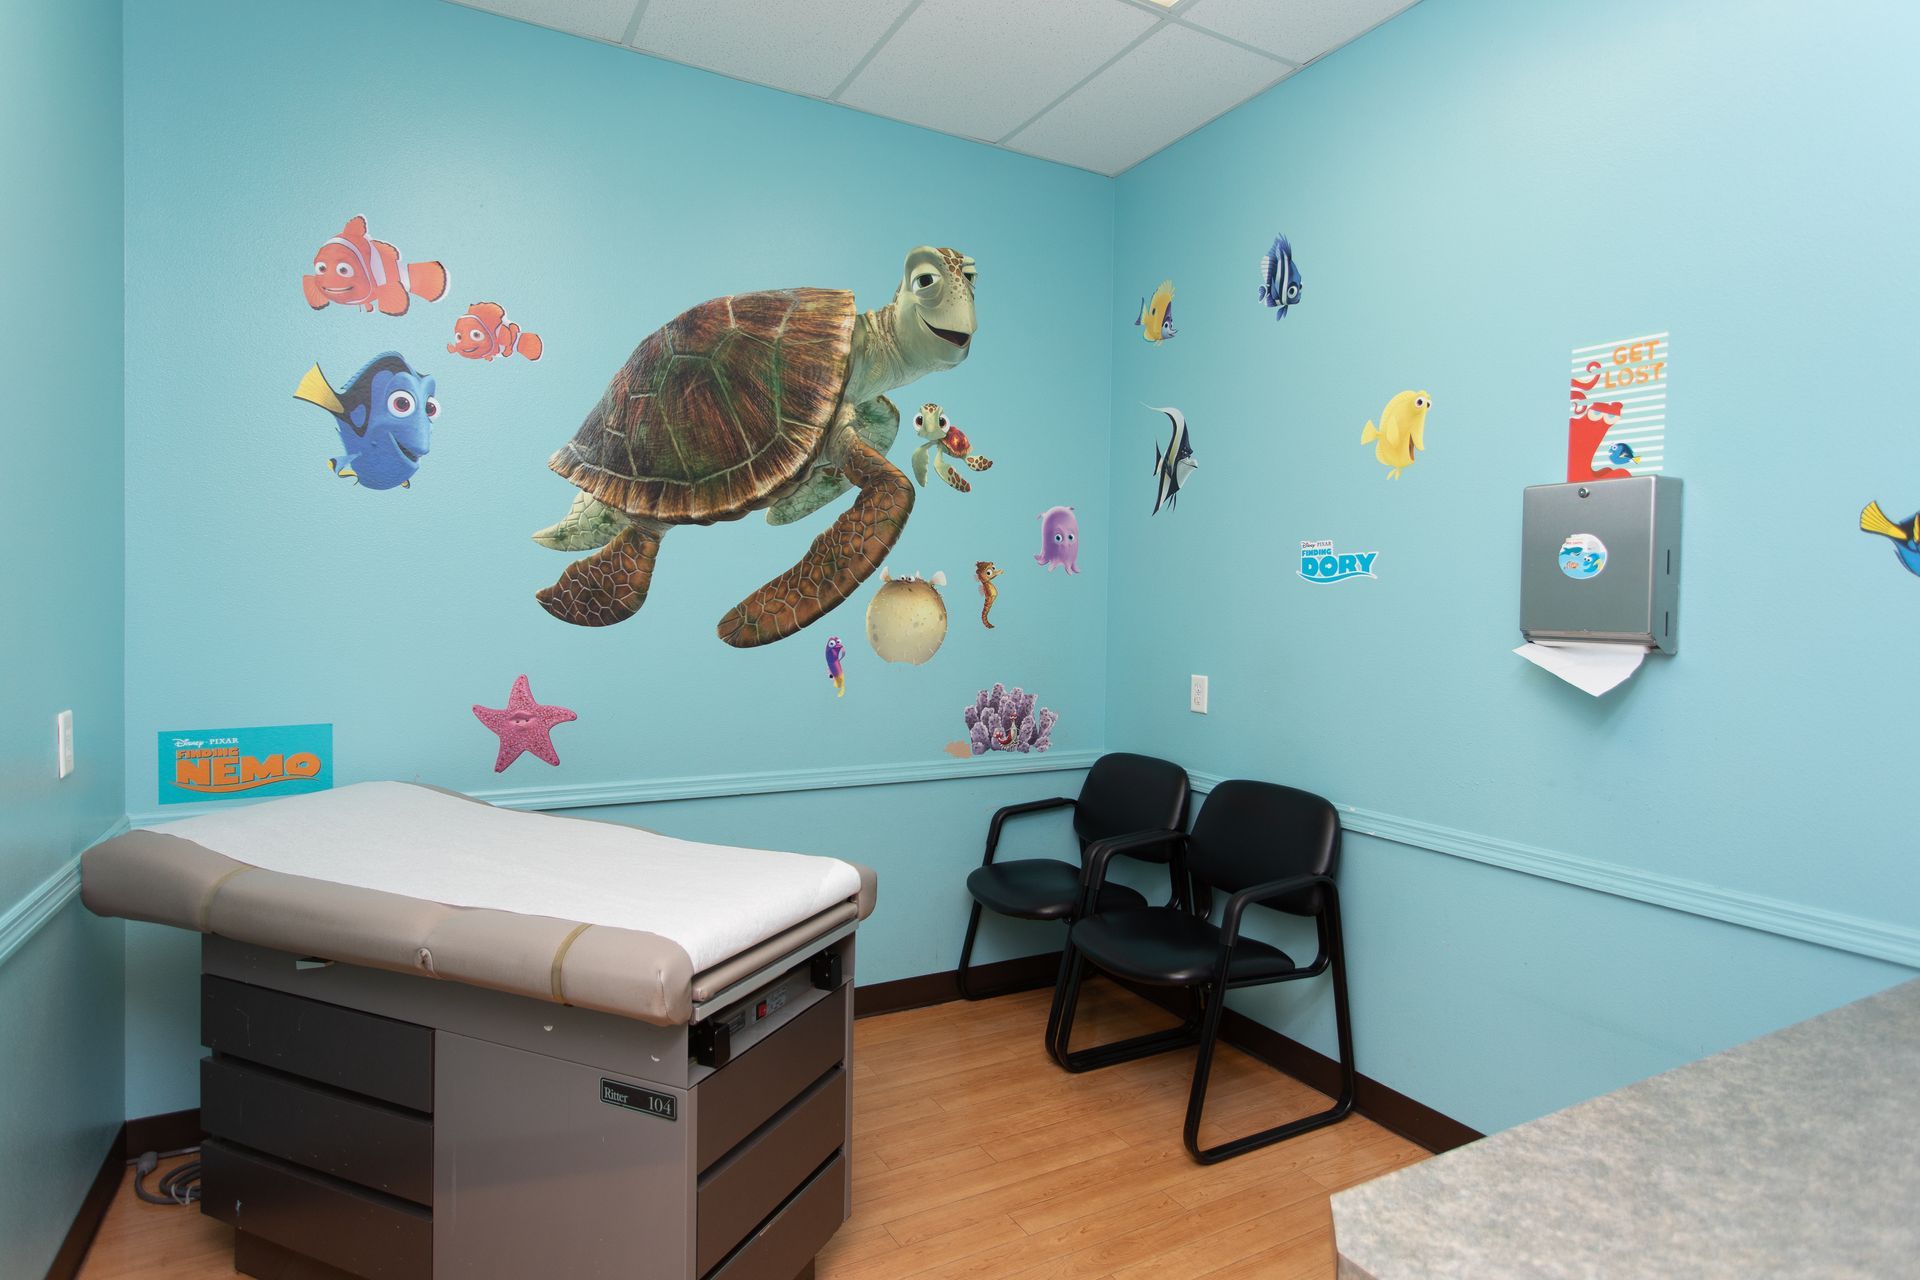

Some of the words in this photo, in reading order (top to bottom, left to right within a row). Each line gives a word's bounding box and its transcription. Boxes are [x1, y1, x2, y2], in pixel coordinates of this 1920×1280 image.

[1612, 340, 1660, 366] GET
[1604, 362, 1665, 389] LOST
[1302, 548, 1332, 556] FINDING
[1302, 553, 1377, 577] DORY
[172, 738, 204, 748] Disney
[209, 737, 239, 745] PIXAR
[176, 747, 239, 760] FINDING
[176, 752, 321, 786] NEMO
[603, 1086, 628, 1103] Ritter
[648, 1096, 672, 1115] 104
